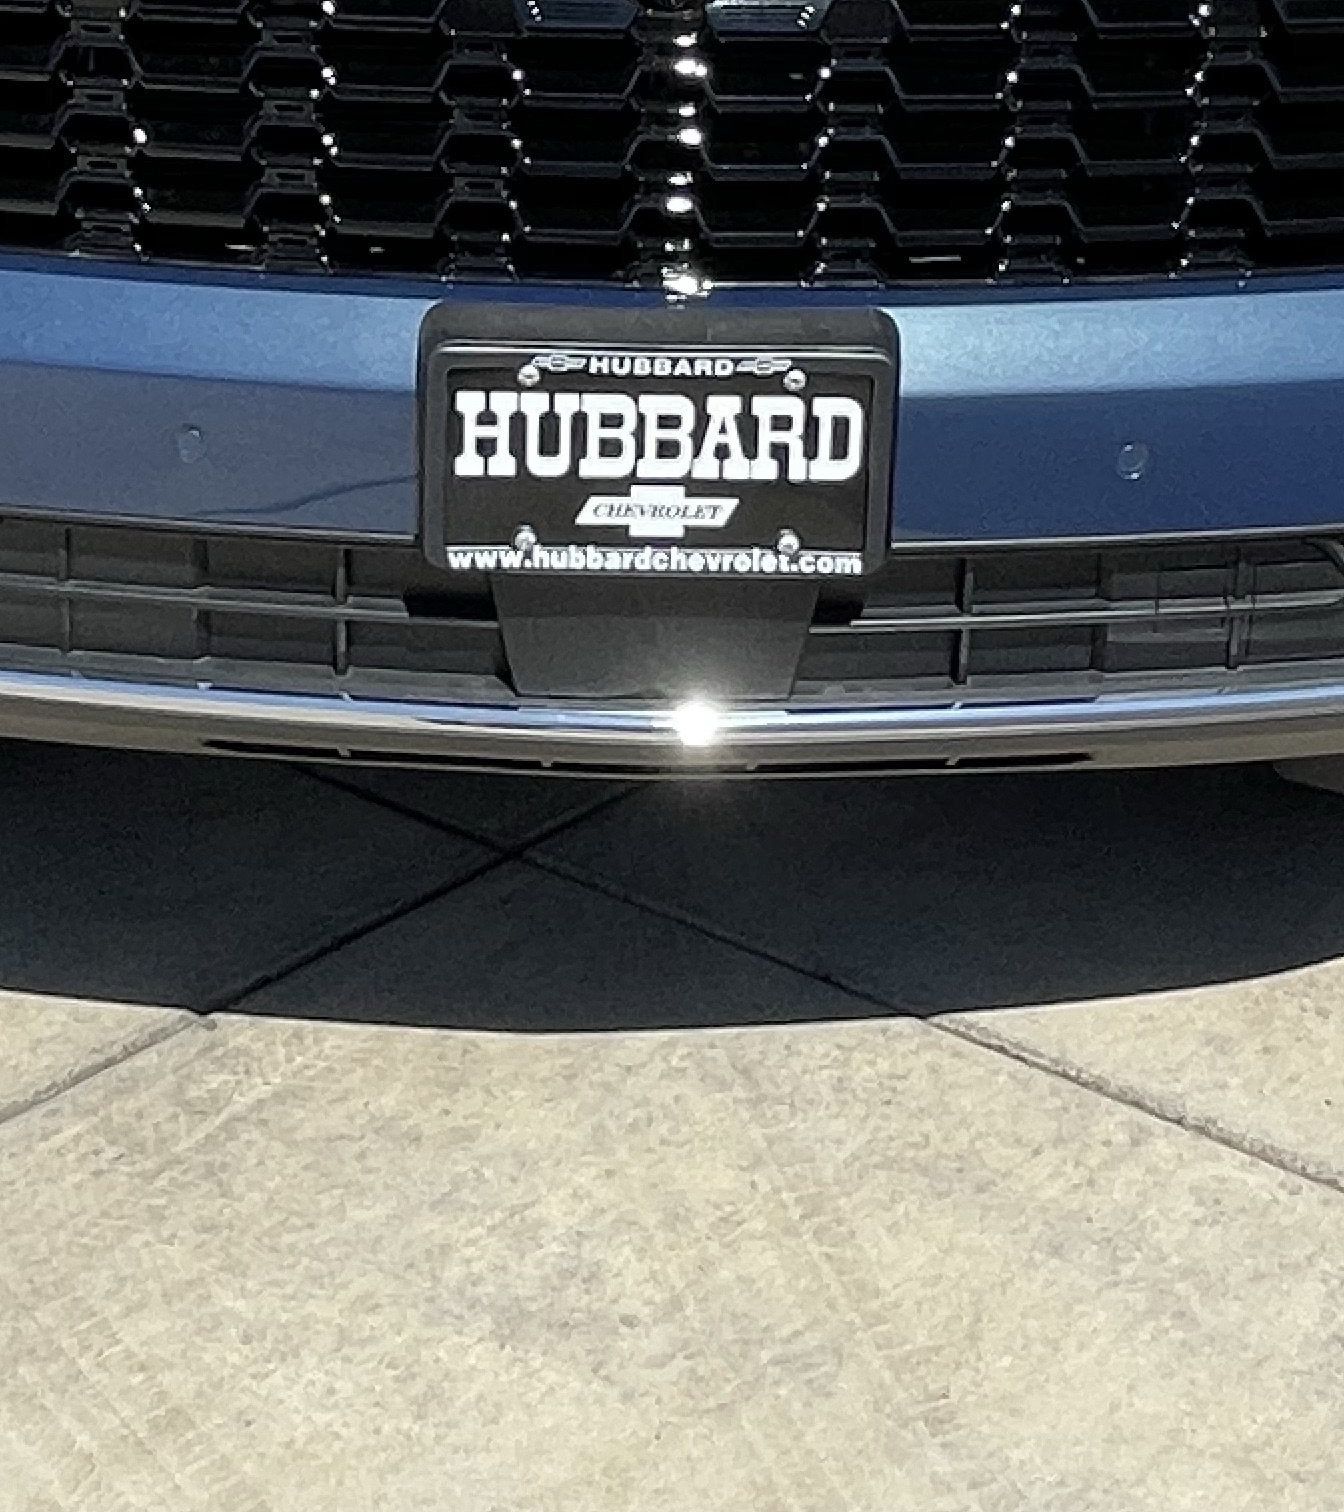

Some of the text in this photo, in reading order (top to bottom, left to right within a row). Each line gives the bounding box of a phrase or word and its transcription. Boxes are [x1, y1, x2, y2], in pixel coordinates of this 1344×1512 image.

[589, 356, 735, 376] HUBBARD
[454, 390, 865, 483] HUBBARD
[592, 503, 724, 519] CHEVROLET
[447, 544, 862, 574] www.hubbardchevrolet.com
